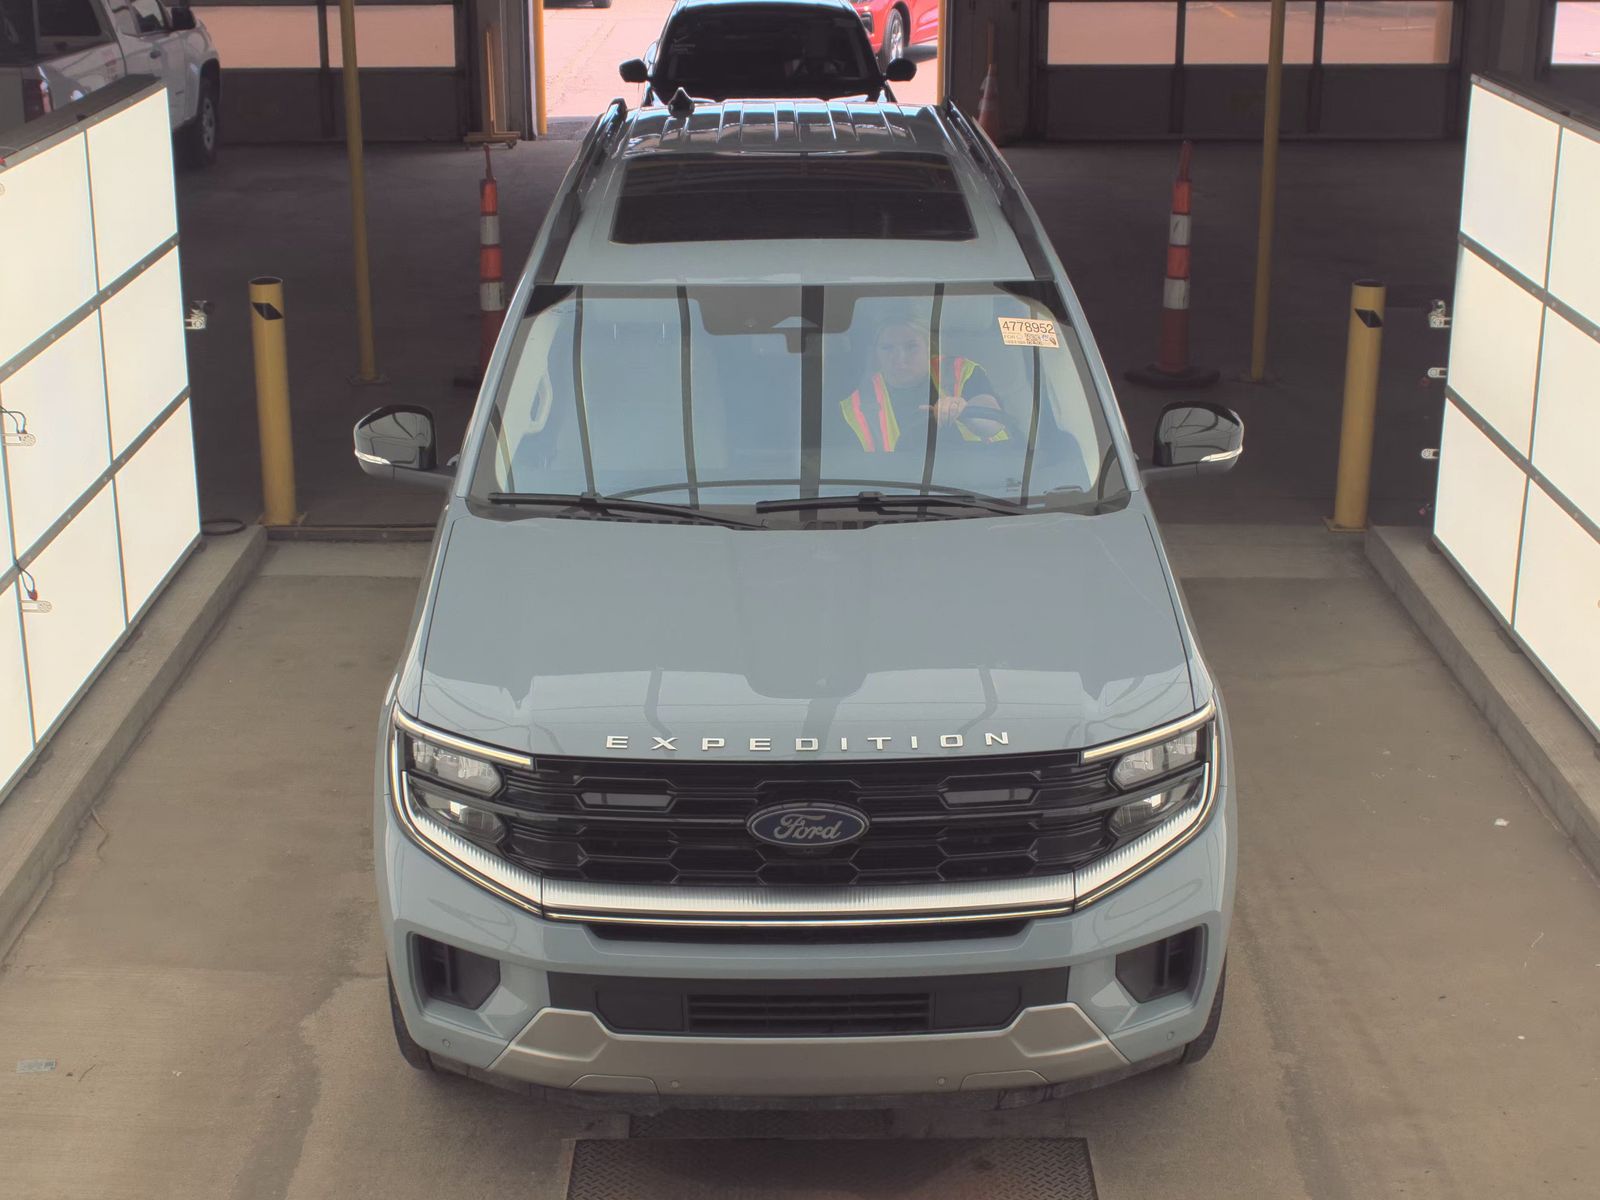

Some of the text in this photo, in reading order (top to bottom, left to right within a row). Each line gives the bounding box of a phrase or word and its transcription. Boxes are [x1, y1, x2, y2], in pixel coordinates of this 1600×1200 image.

[1002, 321, 1055, 334] 4778952
[606, 731, 1009, 751] EXPEDITION
[773, 813, 843, 839] Ford
